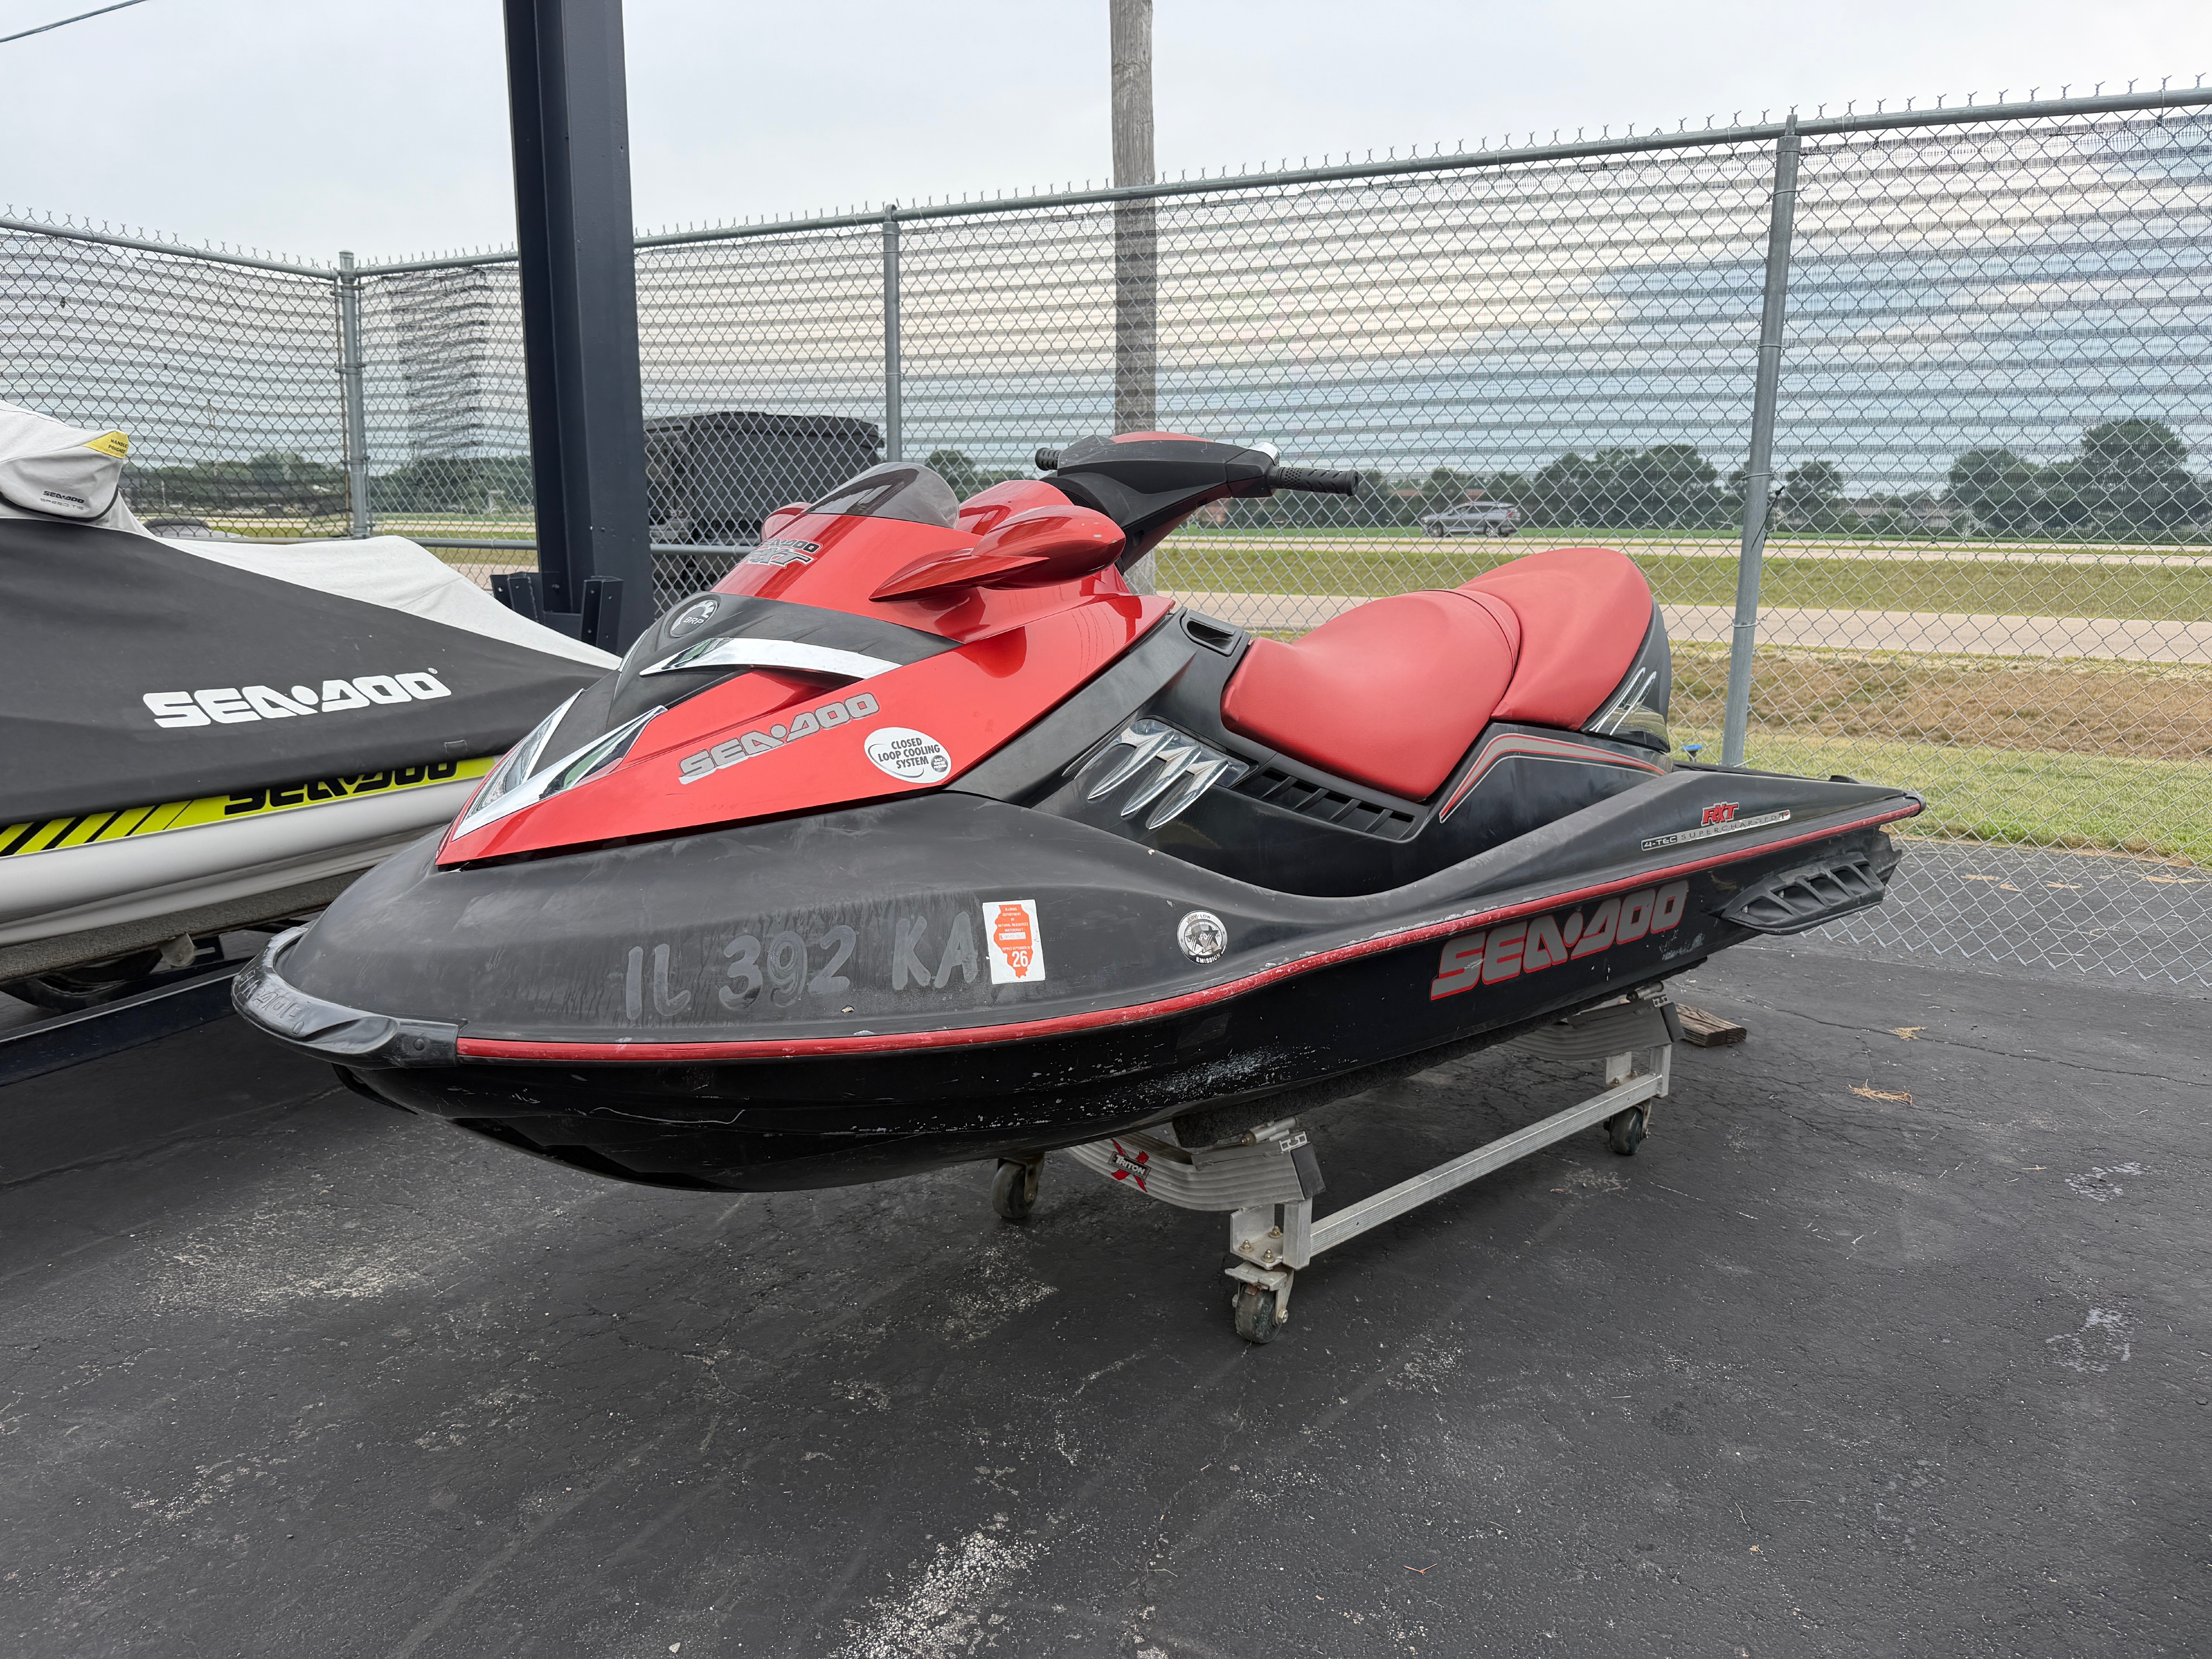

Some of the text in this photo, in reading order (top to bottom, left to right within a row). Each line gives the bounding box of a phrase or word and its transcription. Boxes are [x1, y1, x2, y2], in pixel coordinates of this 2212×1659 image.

[110, 439, 128, 448] HANDLE
[891, 737, 922, 749] CLOSED
[878, 744, 940, 762] LOOP COOLING
[896, 756, 929, 769] SYSTEM
[1702, 802, 1739, 825] RXT
[1644, 815, 1777, 847] 4-TEC SUPERCHARGED
[1186, 914, 1198, 924] VERY
[626, 911, 979, 1020] IL 392 KA
[1012, 950, 1029, 967] 26
[1196, 953, 1221, 963] EMISSION
[1116, 1155, 1146, 1175] TRITON
